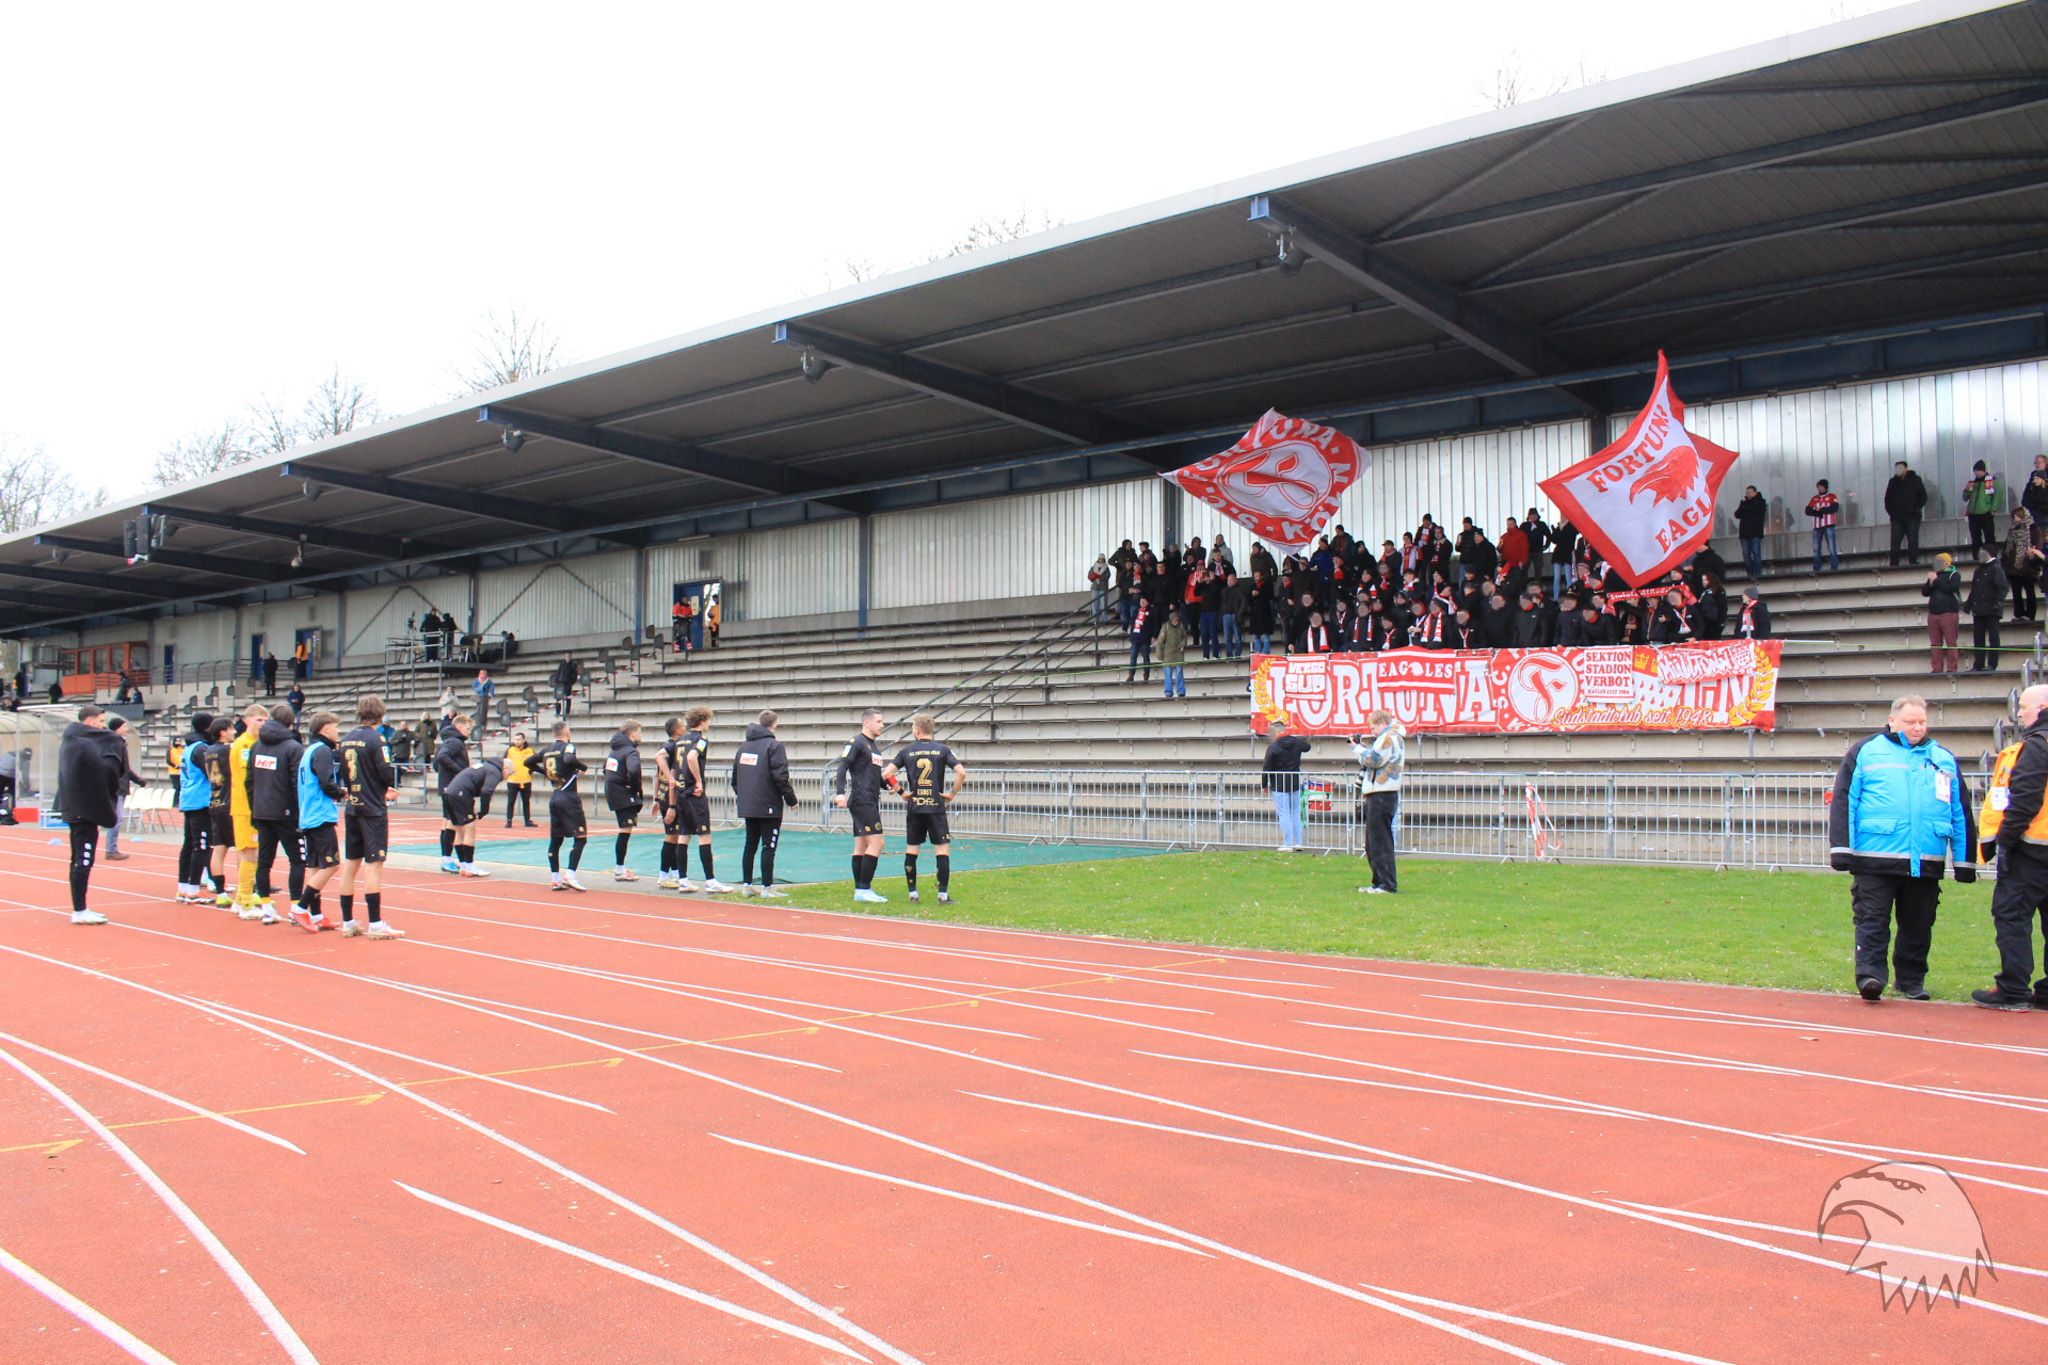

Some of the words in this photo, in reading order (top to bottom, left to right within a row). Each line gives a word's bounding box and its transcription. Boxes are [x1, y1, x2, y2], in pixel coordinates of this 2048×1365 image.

[1585, 651, 1632, 662] SEKTION
[1585, 664, 1632, 674] STADION
[1585, 676, 1630, 687] VERBOT
[1551, 703, 1642, 725] Südstadtclub
[1645, 709, 1672, 725] seit
[1674, 707, 1712, 727] 1948
[916, 757, 933, 786] 2
